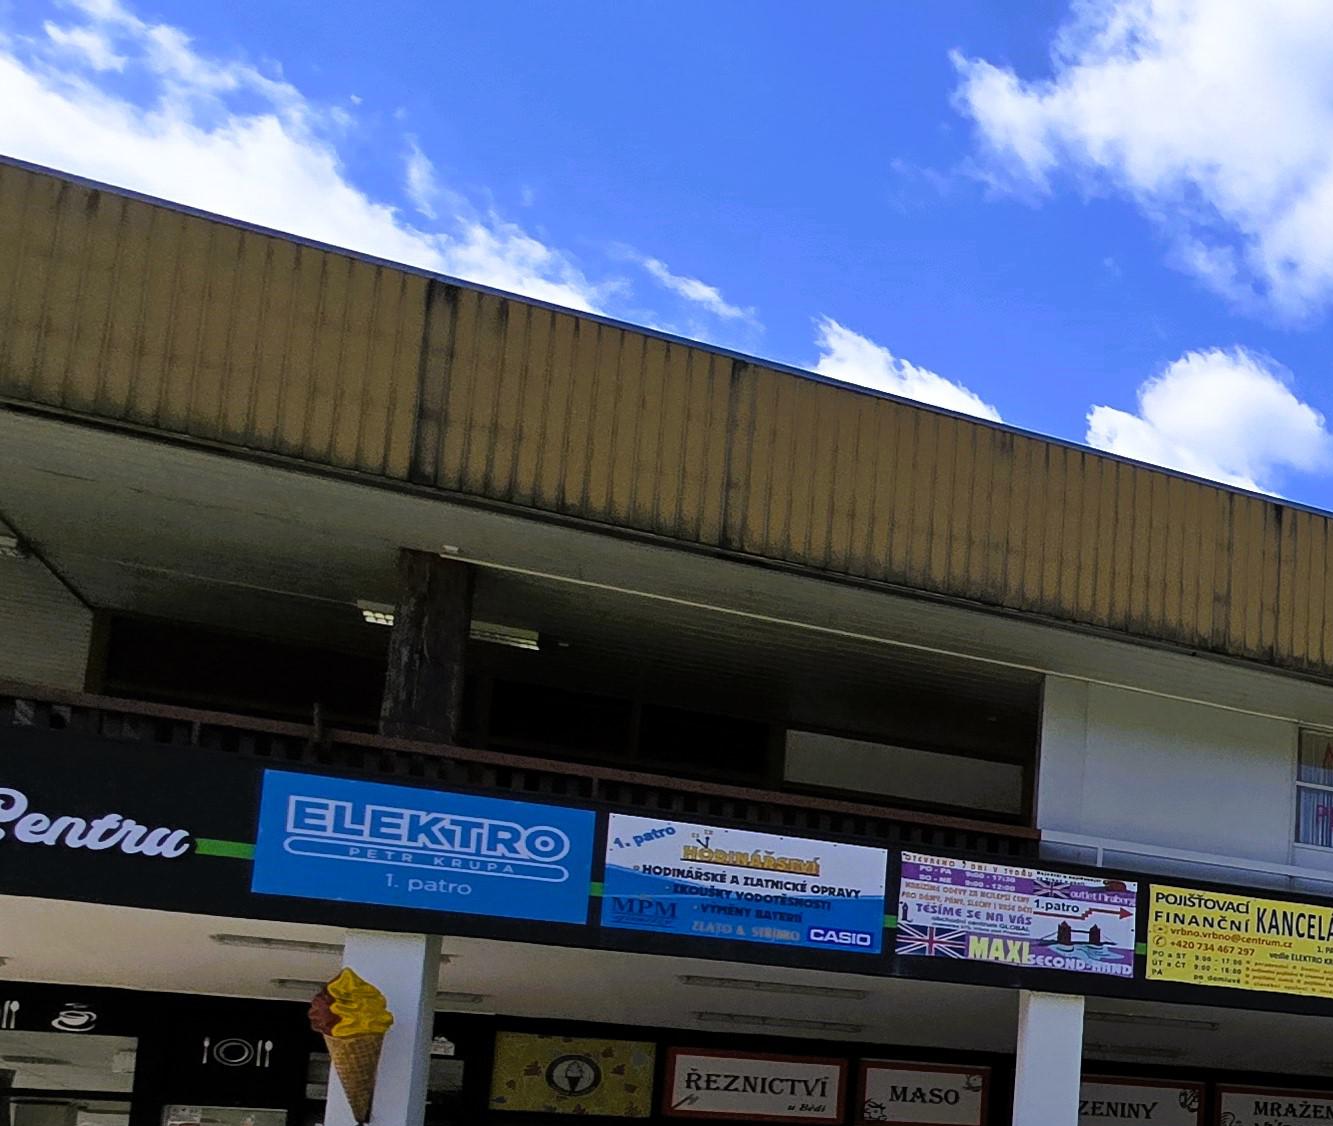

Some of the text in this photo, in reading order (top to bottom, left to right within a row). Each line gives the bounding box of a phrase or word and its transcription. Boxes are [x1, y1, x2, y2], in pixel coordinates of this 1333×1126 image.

[286, 795, 570, 862] ELEKTRO
[612, 837, 631, 849] 1.
[632, 826, 676, 847] patro
[349, 847, 515, 874] PETR KRUPA
[683, 844, 820, 875] HODINÁŘSTVÍ
[384, 872, 472, 896] 1. patro
[642, 864, 861, 899] HODINÁŘSKÉ A ZLATNICKÉ OPRAVY
[611, 896, 678, 918] MPM
[1155, 892, 1250, 914] POJIŠŤOVACÍ
[692, 921, 732, 935] ZLATO
[966, 909, 981, 920] SE
[986, 911, 1003, 922] NA
[1008, 914, 1033, 926] VÁS
[1154, 911, 1250, 933] FINANČNÍ
[809, 928, 871, 946] CASIO
[1170, 927, 1293, 948] vrbno.vrbno@centrum.cz
[1170, 940, 1255, 956] +420 734 467 297
[968, 935, 1030, 964] MAXI
[1291, 954, 1322, 964] ELEKTRO
[1027, 954, 1132, 975] SECOND-HAND
[685, 1067, 830, 1098] ŘEZNICTVÍ
[889, 1085, 960, 1106] MASO
[1078, 1099, 1159, 1120] ZENINY
